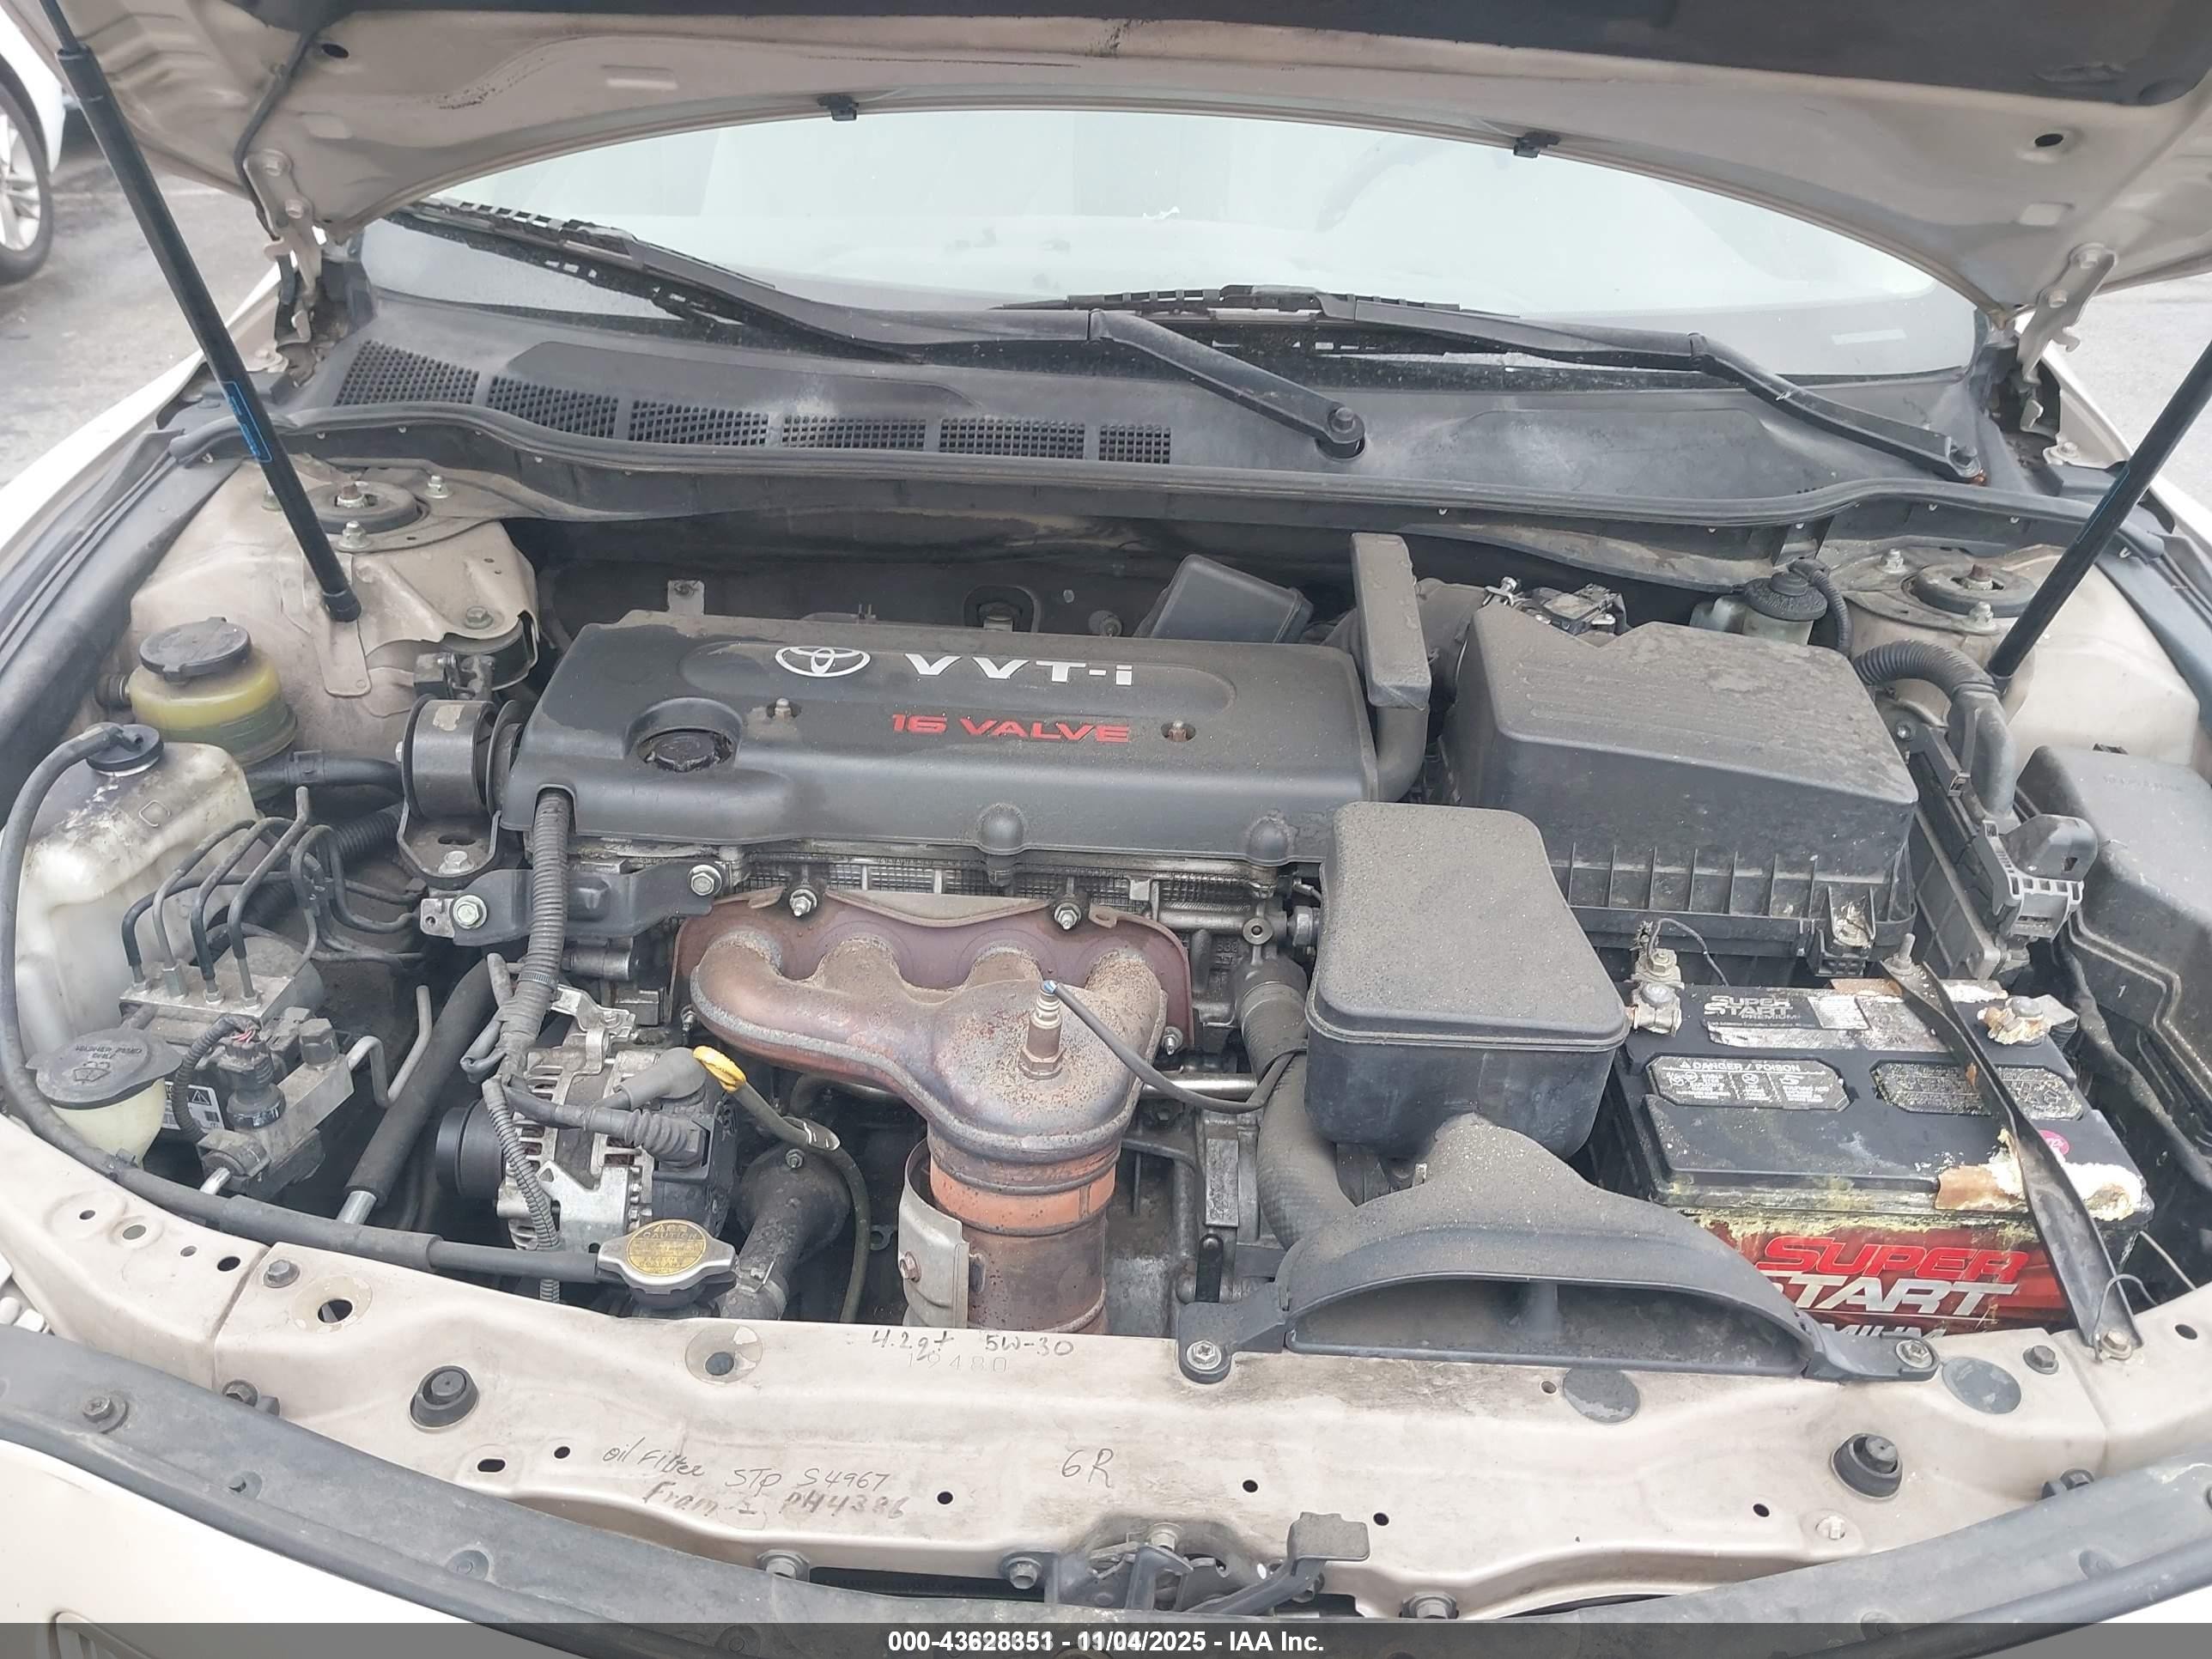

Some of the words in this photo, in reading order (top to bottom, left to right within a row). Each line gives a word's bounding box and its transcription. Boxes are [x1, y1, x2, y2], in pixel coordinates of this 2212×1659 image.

[905, 653, 1133, 686] VVT-i
[893, 714, 948, 735] 16
[959, 718, 1131, 743] VALVE
[1704, 1002, 1794, 1017] START
[1711, 994, 1790, 1007] SUPER
[1692, 1060, 1742, 1072] DANGER
[1755, 1062, 1801, 1073] POISON
[1756, 1235, 2029, 1283] SUPER
[986, 1334, 1074, 1357] 5W-30
